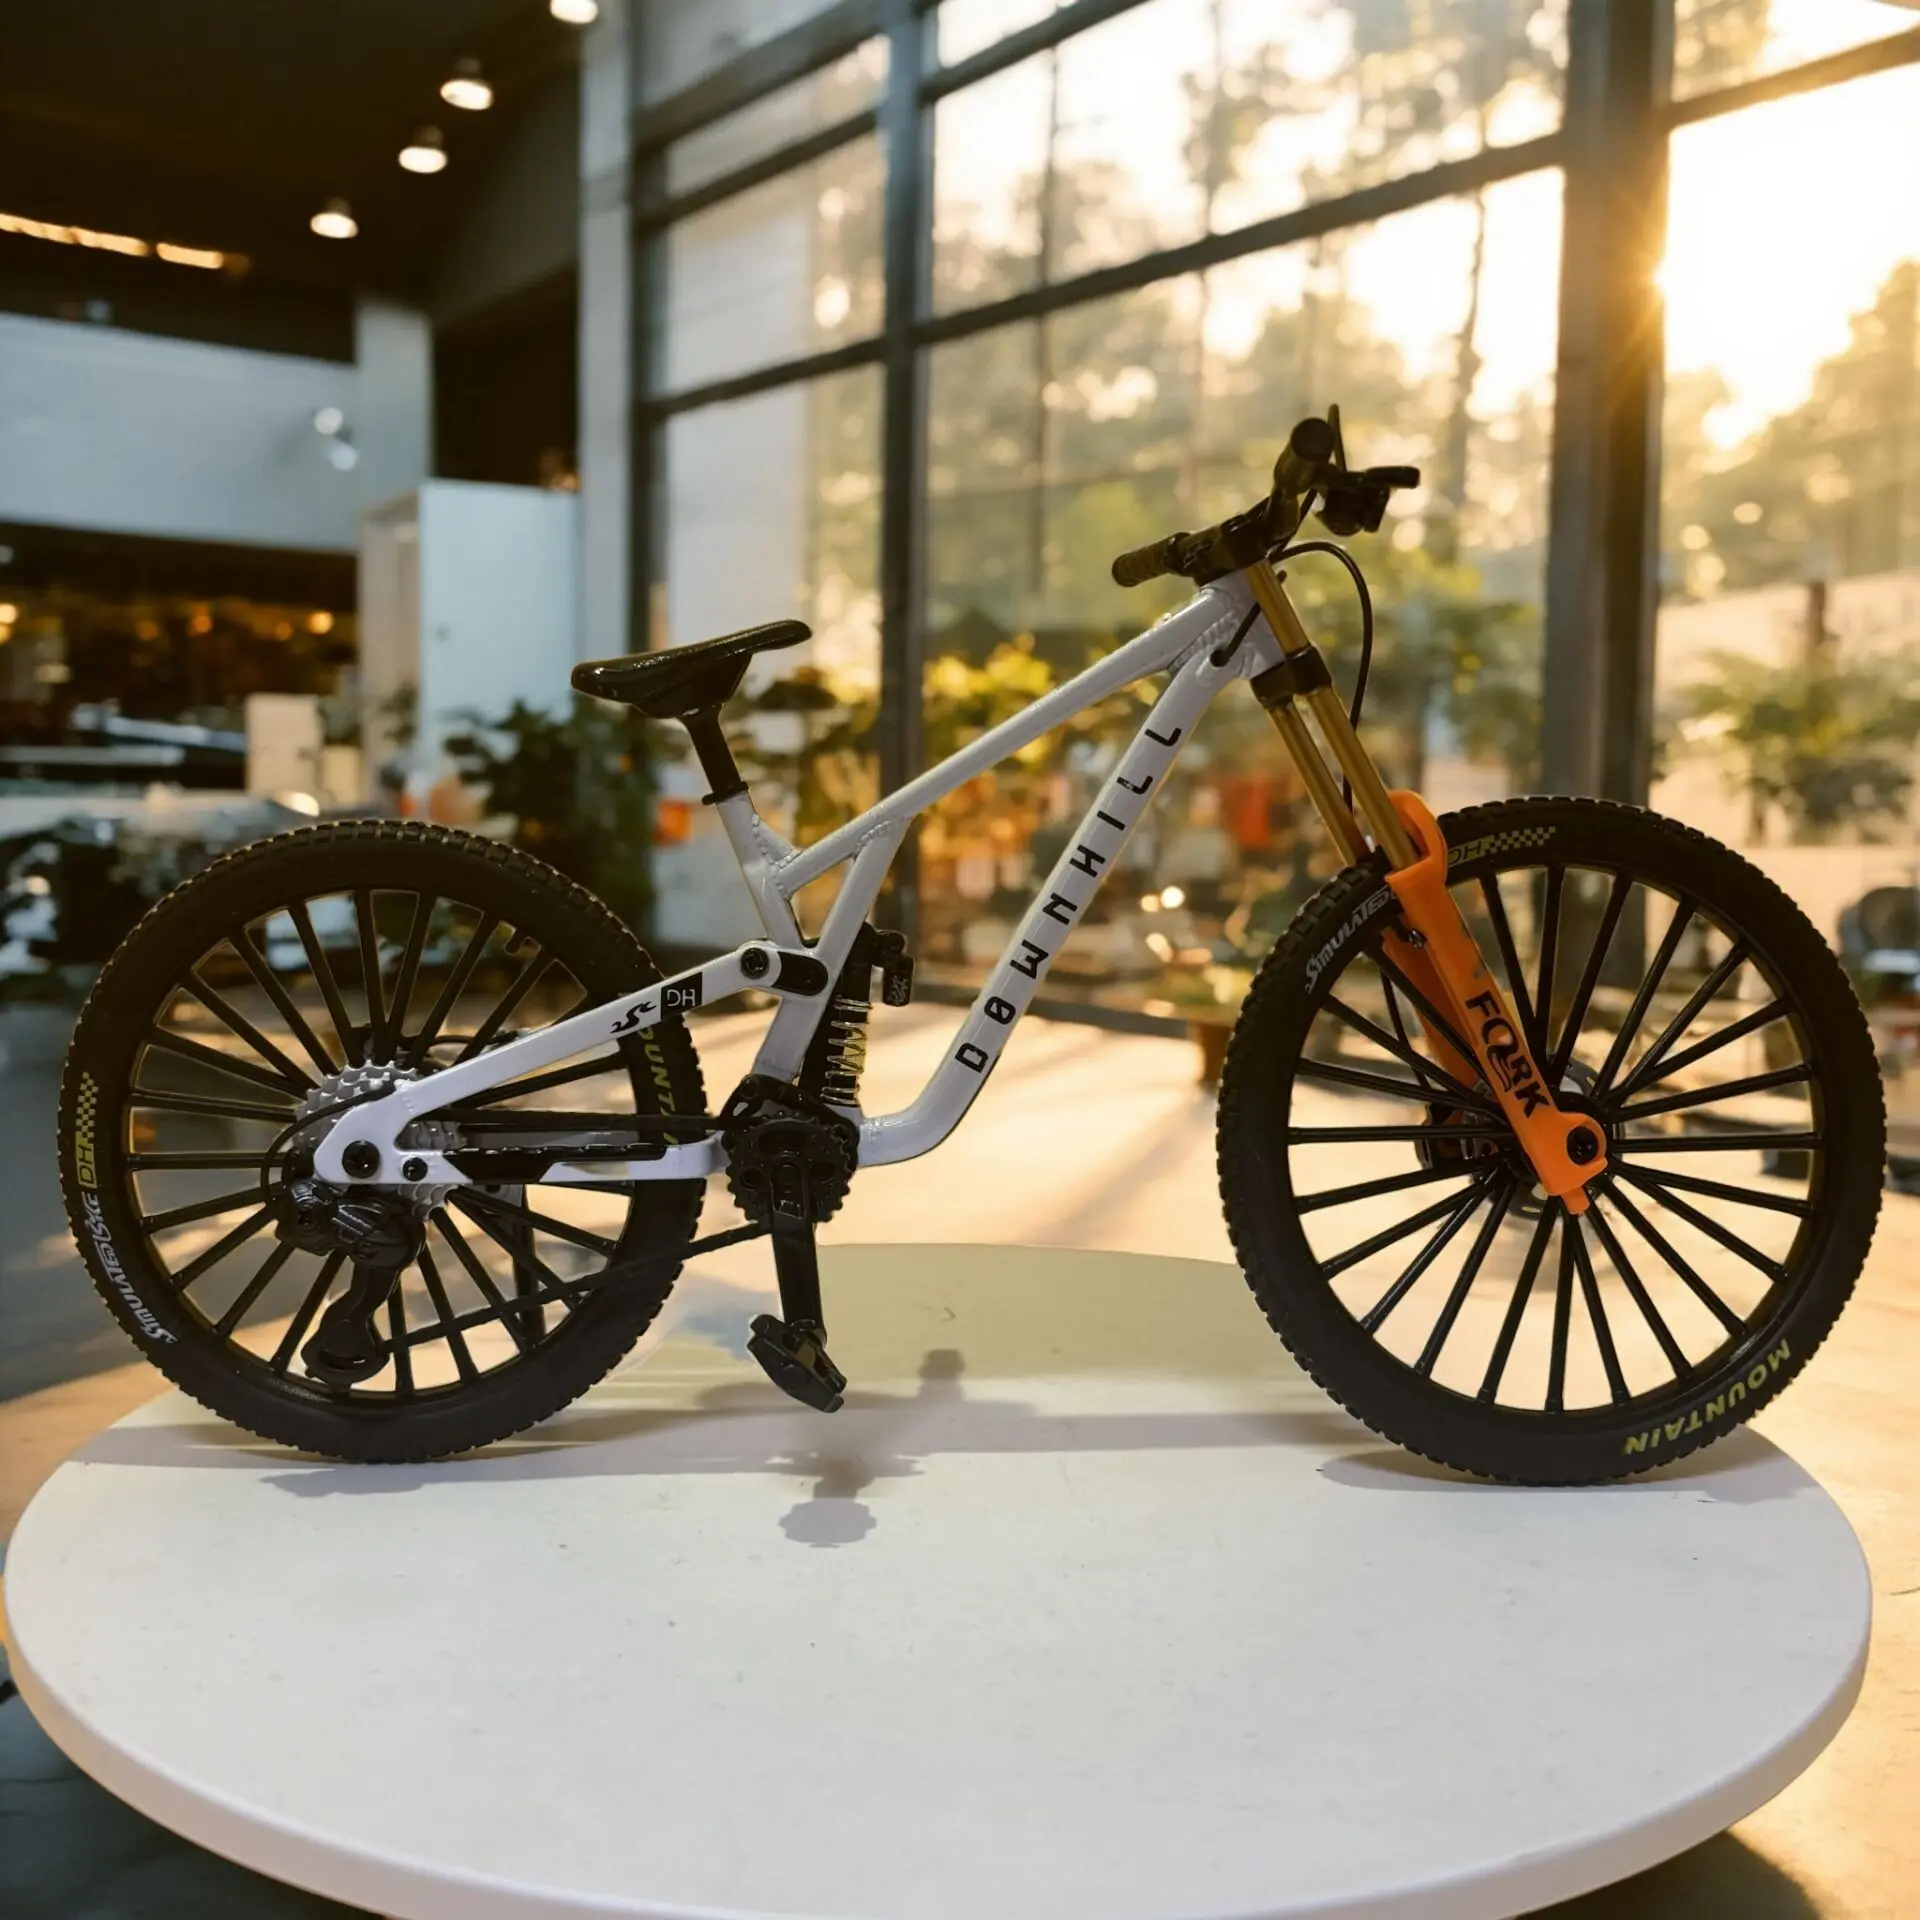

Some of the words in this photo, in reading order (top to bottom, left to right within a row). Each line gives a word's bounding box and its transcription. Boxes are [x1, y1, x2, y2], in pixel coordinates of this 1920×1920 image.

[666, 988, 697, 1007] DH
[1465, 990, 1550, 1118] FORK
[78, 1142, 96, 1185] DH
[1622, 1338, 1792, 1455] MOUNTAIN
